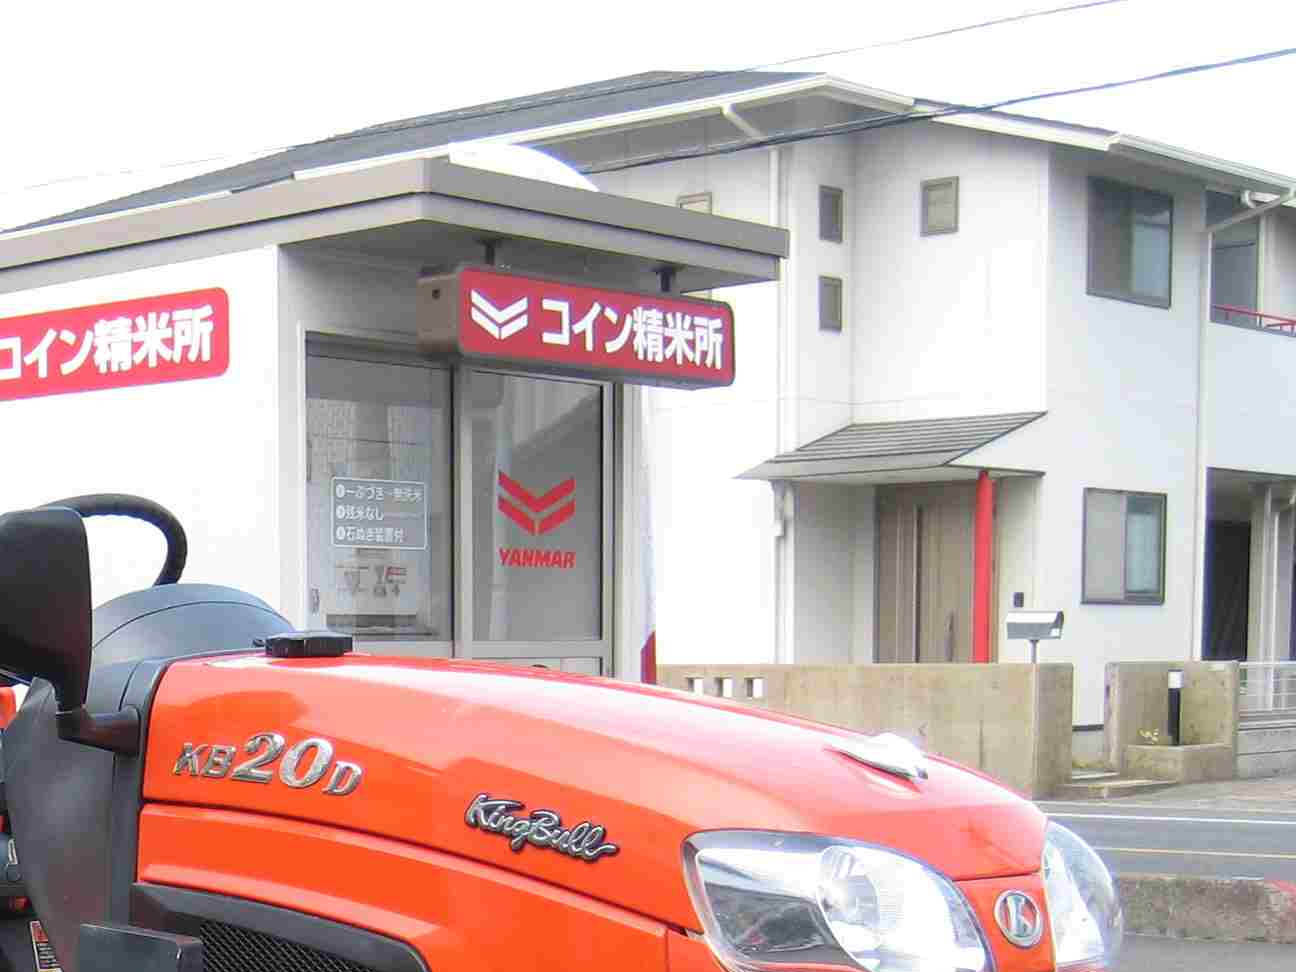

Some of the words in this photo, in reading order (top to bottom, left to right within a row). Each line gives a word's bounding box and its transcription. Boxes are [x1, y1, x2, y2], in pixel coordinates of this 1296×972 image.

[541, 298, 724, 370] コイン精米所
[498, 547, 576, 569] YANMAR
